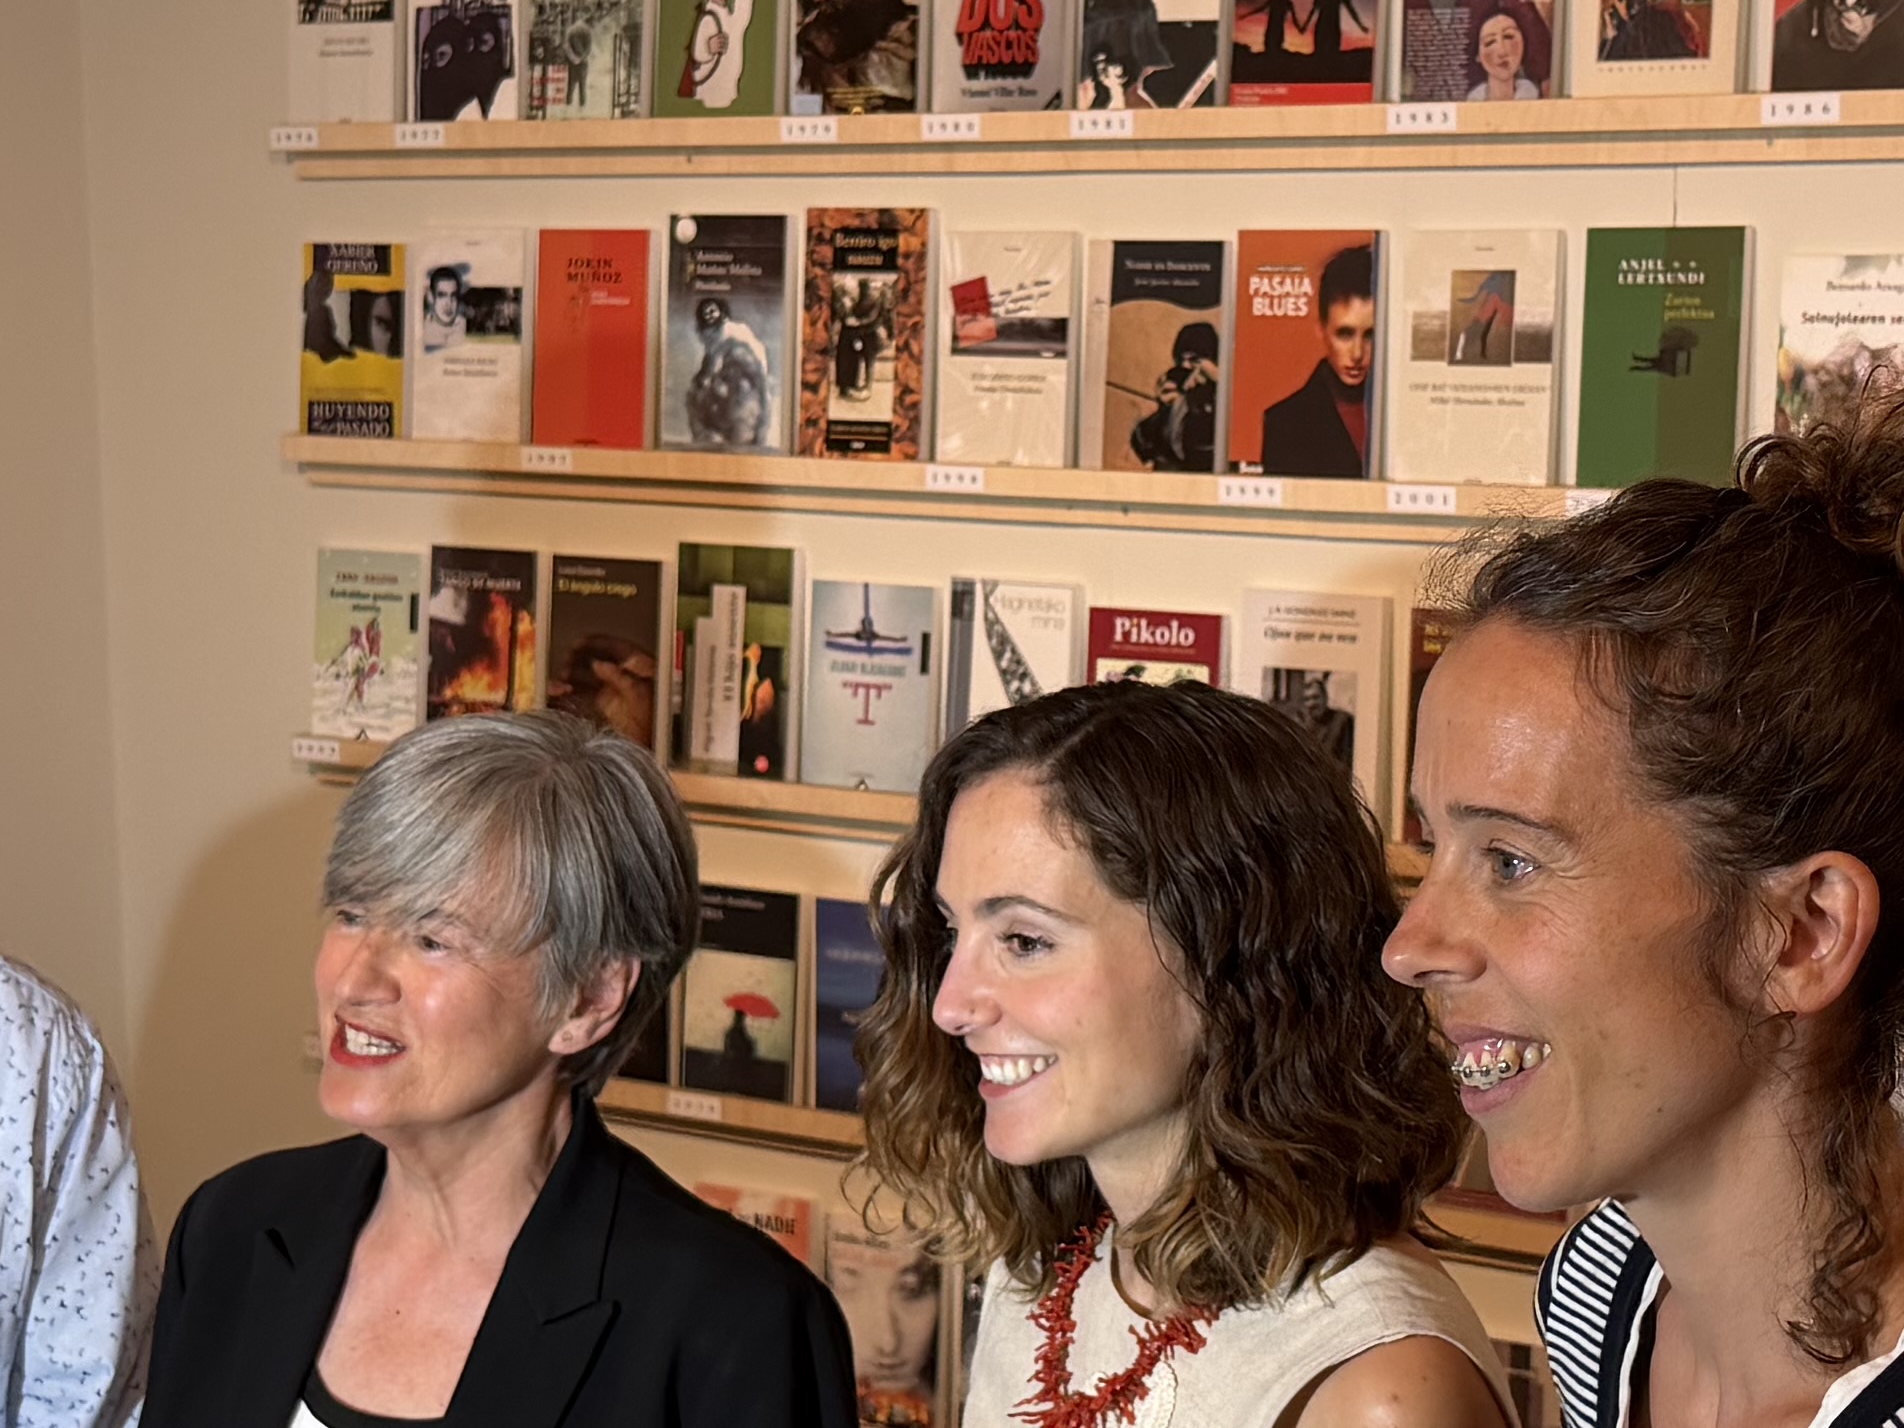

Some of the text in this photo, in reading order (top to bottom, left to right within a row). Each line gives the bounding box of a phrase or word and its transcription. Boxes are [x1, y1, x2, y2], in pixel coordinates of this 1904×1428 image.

[1252, 296, 1309, 317] BLUES
[313, 403, 390, 420] HUYENDO
[1113, 617, 1195, 648] Pikolo
